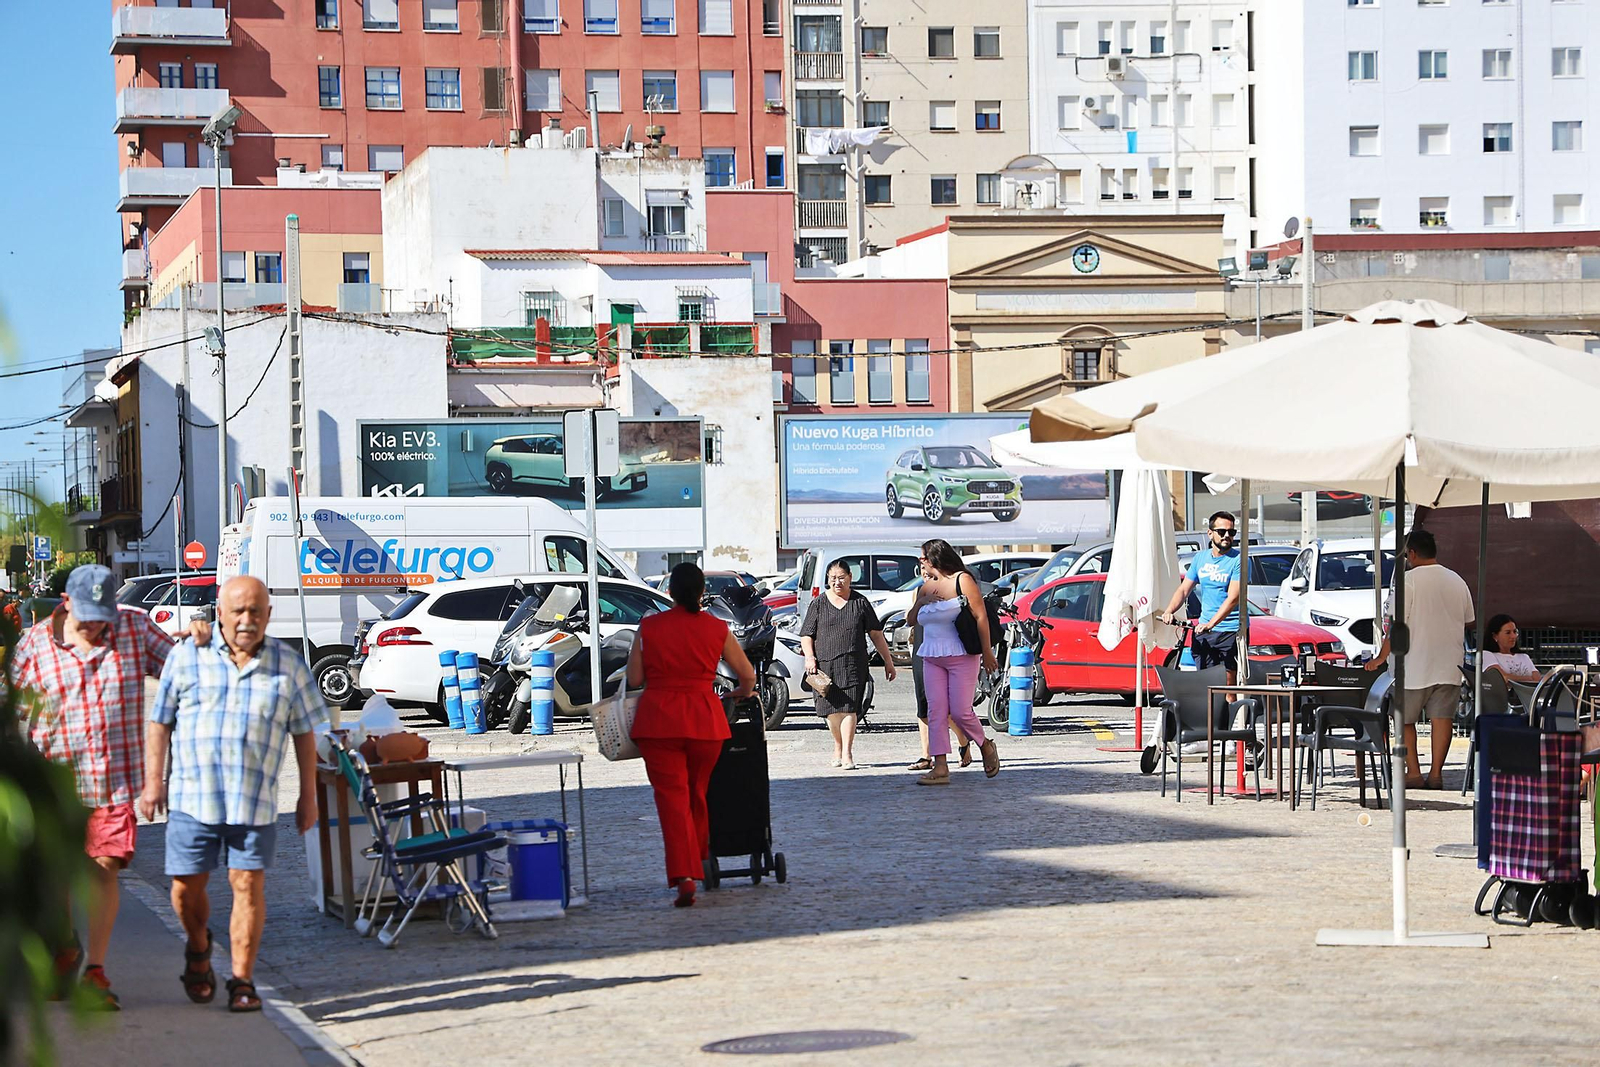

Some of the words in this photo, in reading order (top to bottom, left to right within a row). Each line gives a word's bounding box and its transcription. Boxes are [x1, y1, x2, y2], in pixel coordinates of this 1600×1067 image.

[1073, 294, 1110, 306] ANNO
[792, 426, 838, 439] Nuevo
[842, 426, 878, 440] Kuga
[881, 424, 934, 438] Híbrido
[369, 431, 397, 448] Kia
[402, 431, 441, 448] EV3.
[792, 442, 810, 451] Una
[812, 442, 845, 451] fórmula
[846, 442, 886, 452] poderosa
[370, 451, 395, 461] 100%
[396, 451, 437, 461] eléctrico.
[269, 512, 289, 522] 902
[310, 512, 329, 522] 943
[336, 510, 405, 523] telefurgo.com
[794, 517, 826, 525] DIVESUR
[828, 516, 880, 525] AUTOMOCIÓN
[38, 537, 46, 547] P
[300, 539, 493, 582] telefurgo
[1203, 563, 1219, 572] JUST
[354, 576, 365, 584] DE
[369, 576, 427, 584] FURGONETAS
